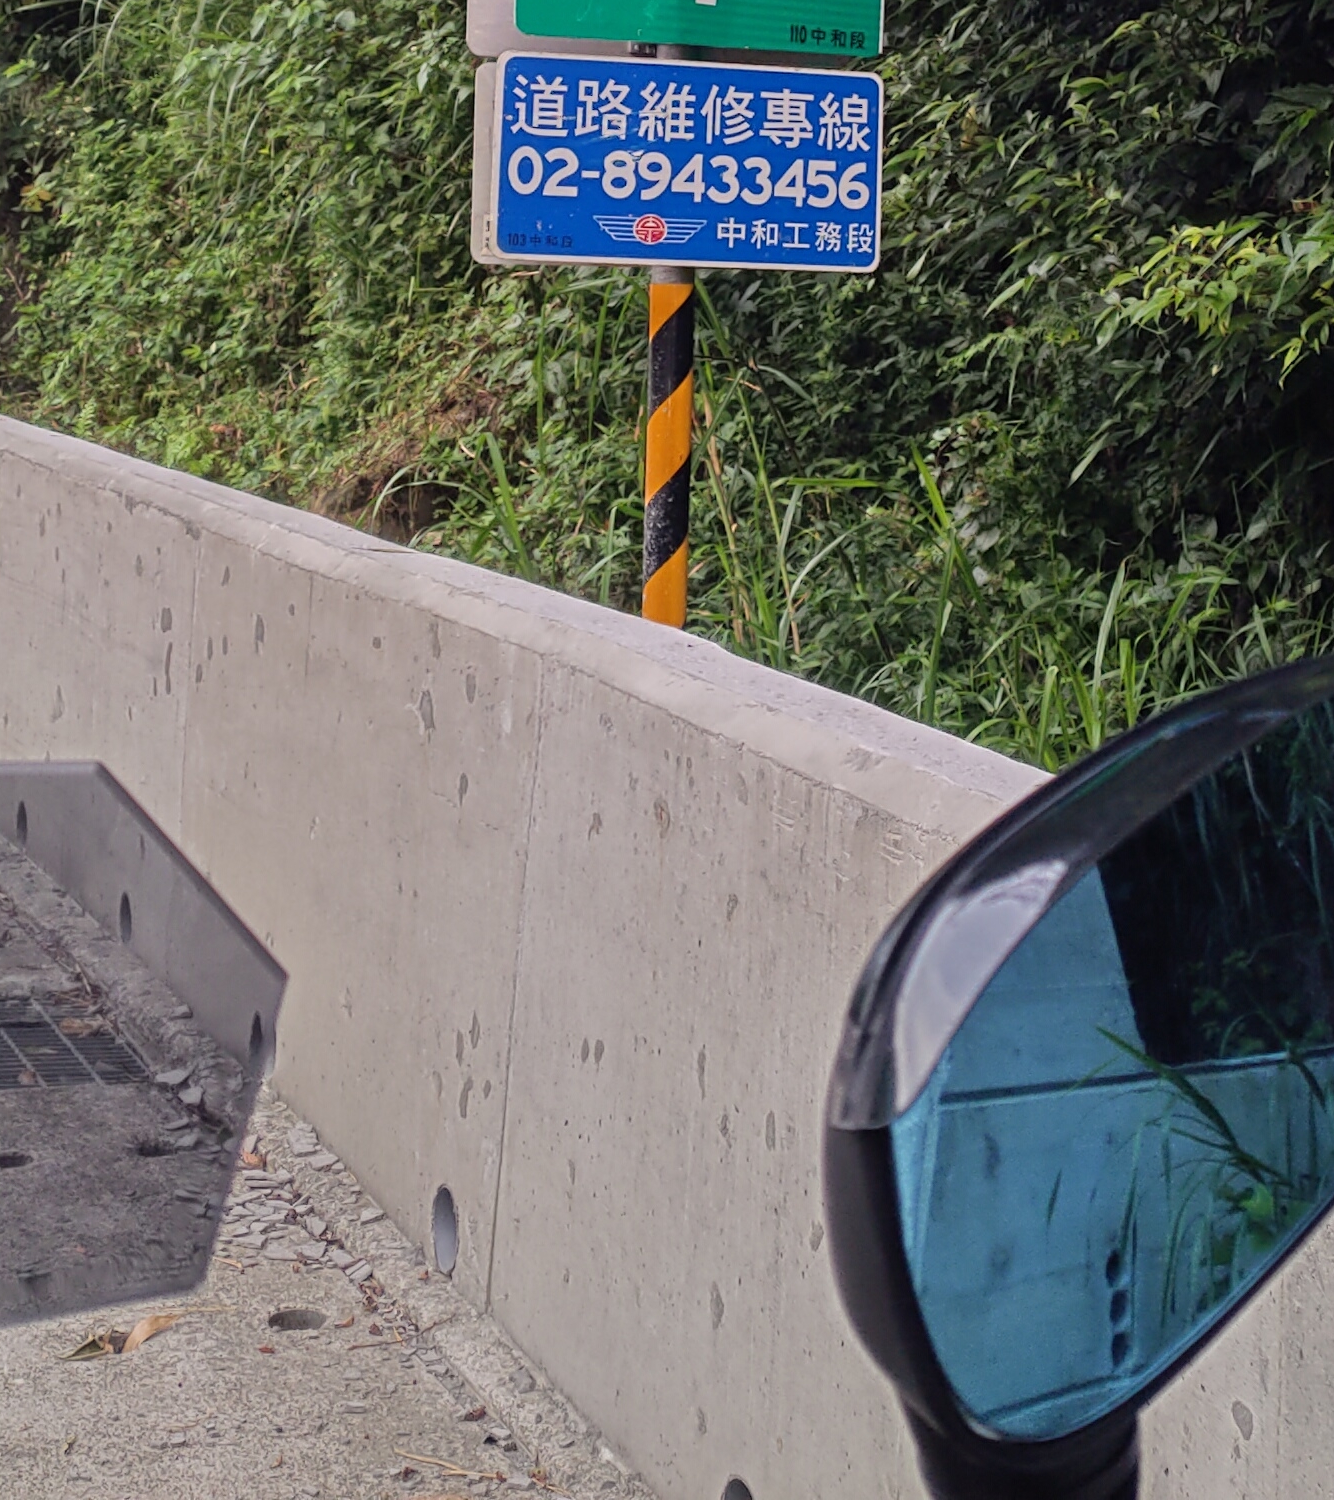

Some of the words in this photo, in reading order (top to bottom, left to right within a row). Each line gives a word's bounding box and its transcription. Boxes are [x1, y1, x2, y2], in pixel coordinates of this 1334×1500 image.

[790, 24, 866, 50] 110中和段
[510, 74, 871, 152] 道路維修專線
[507, 145, 870, 210] 02-89433456
[716, 217, 875, 255] 中和工務段
